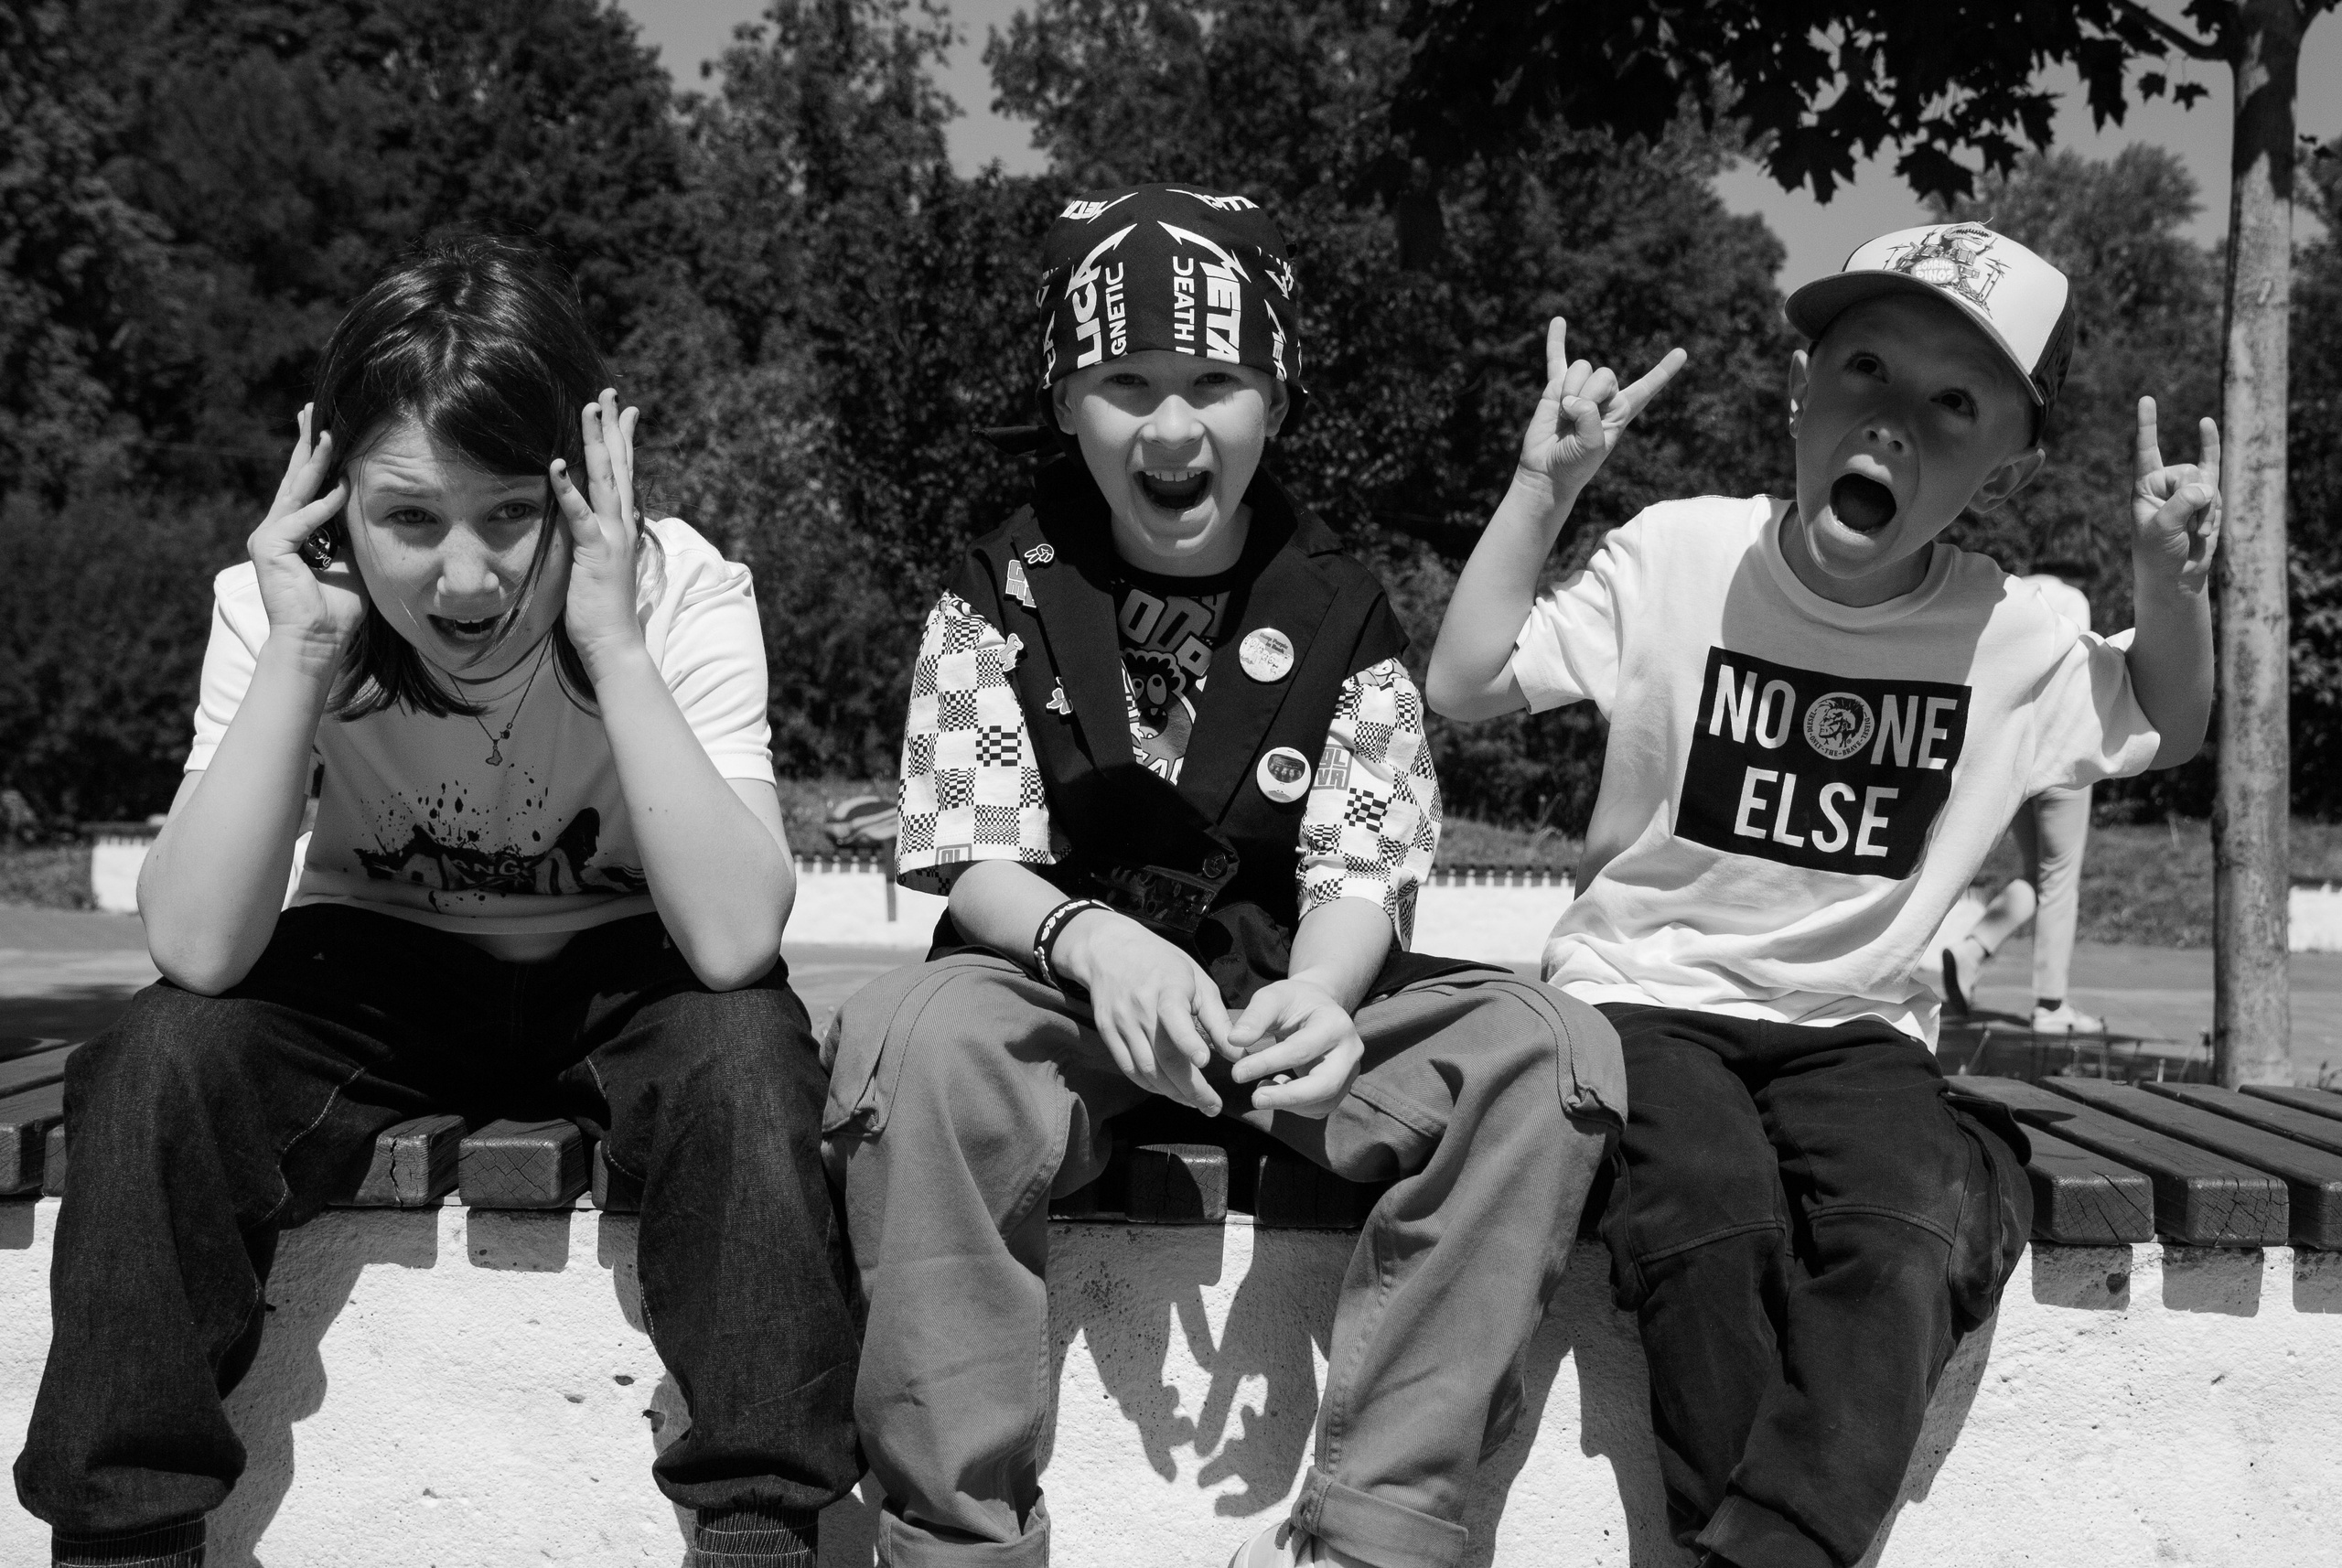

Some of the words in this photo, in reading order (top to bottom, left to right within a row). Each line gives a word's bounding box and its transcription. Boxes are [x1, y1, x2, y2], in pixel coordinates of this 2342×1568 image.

[1915, 269, 1954, 282] DINOS
[1064, 222, 1138, 369] LICA
[1105, 262, 1128, 357] GNETIC
[1709, 664, 1796, 749] NO
[1807, 711, 1817, 733] DIESEL
[1860, 717, 1871, 739] DIESEL
[1810, 736, 1822, 749] ONLY
[1824, 747, 1839, 757] THE
[1842, 740, 1863, 757] BRAVE
[1734, 766, 1899, 857] ELSE
